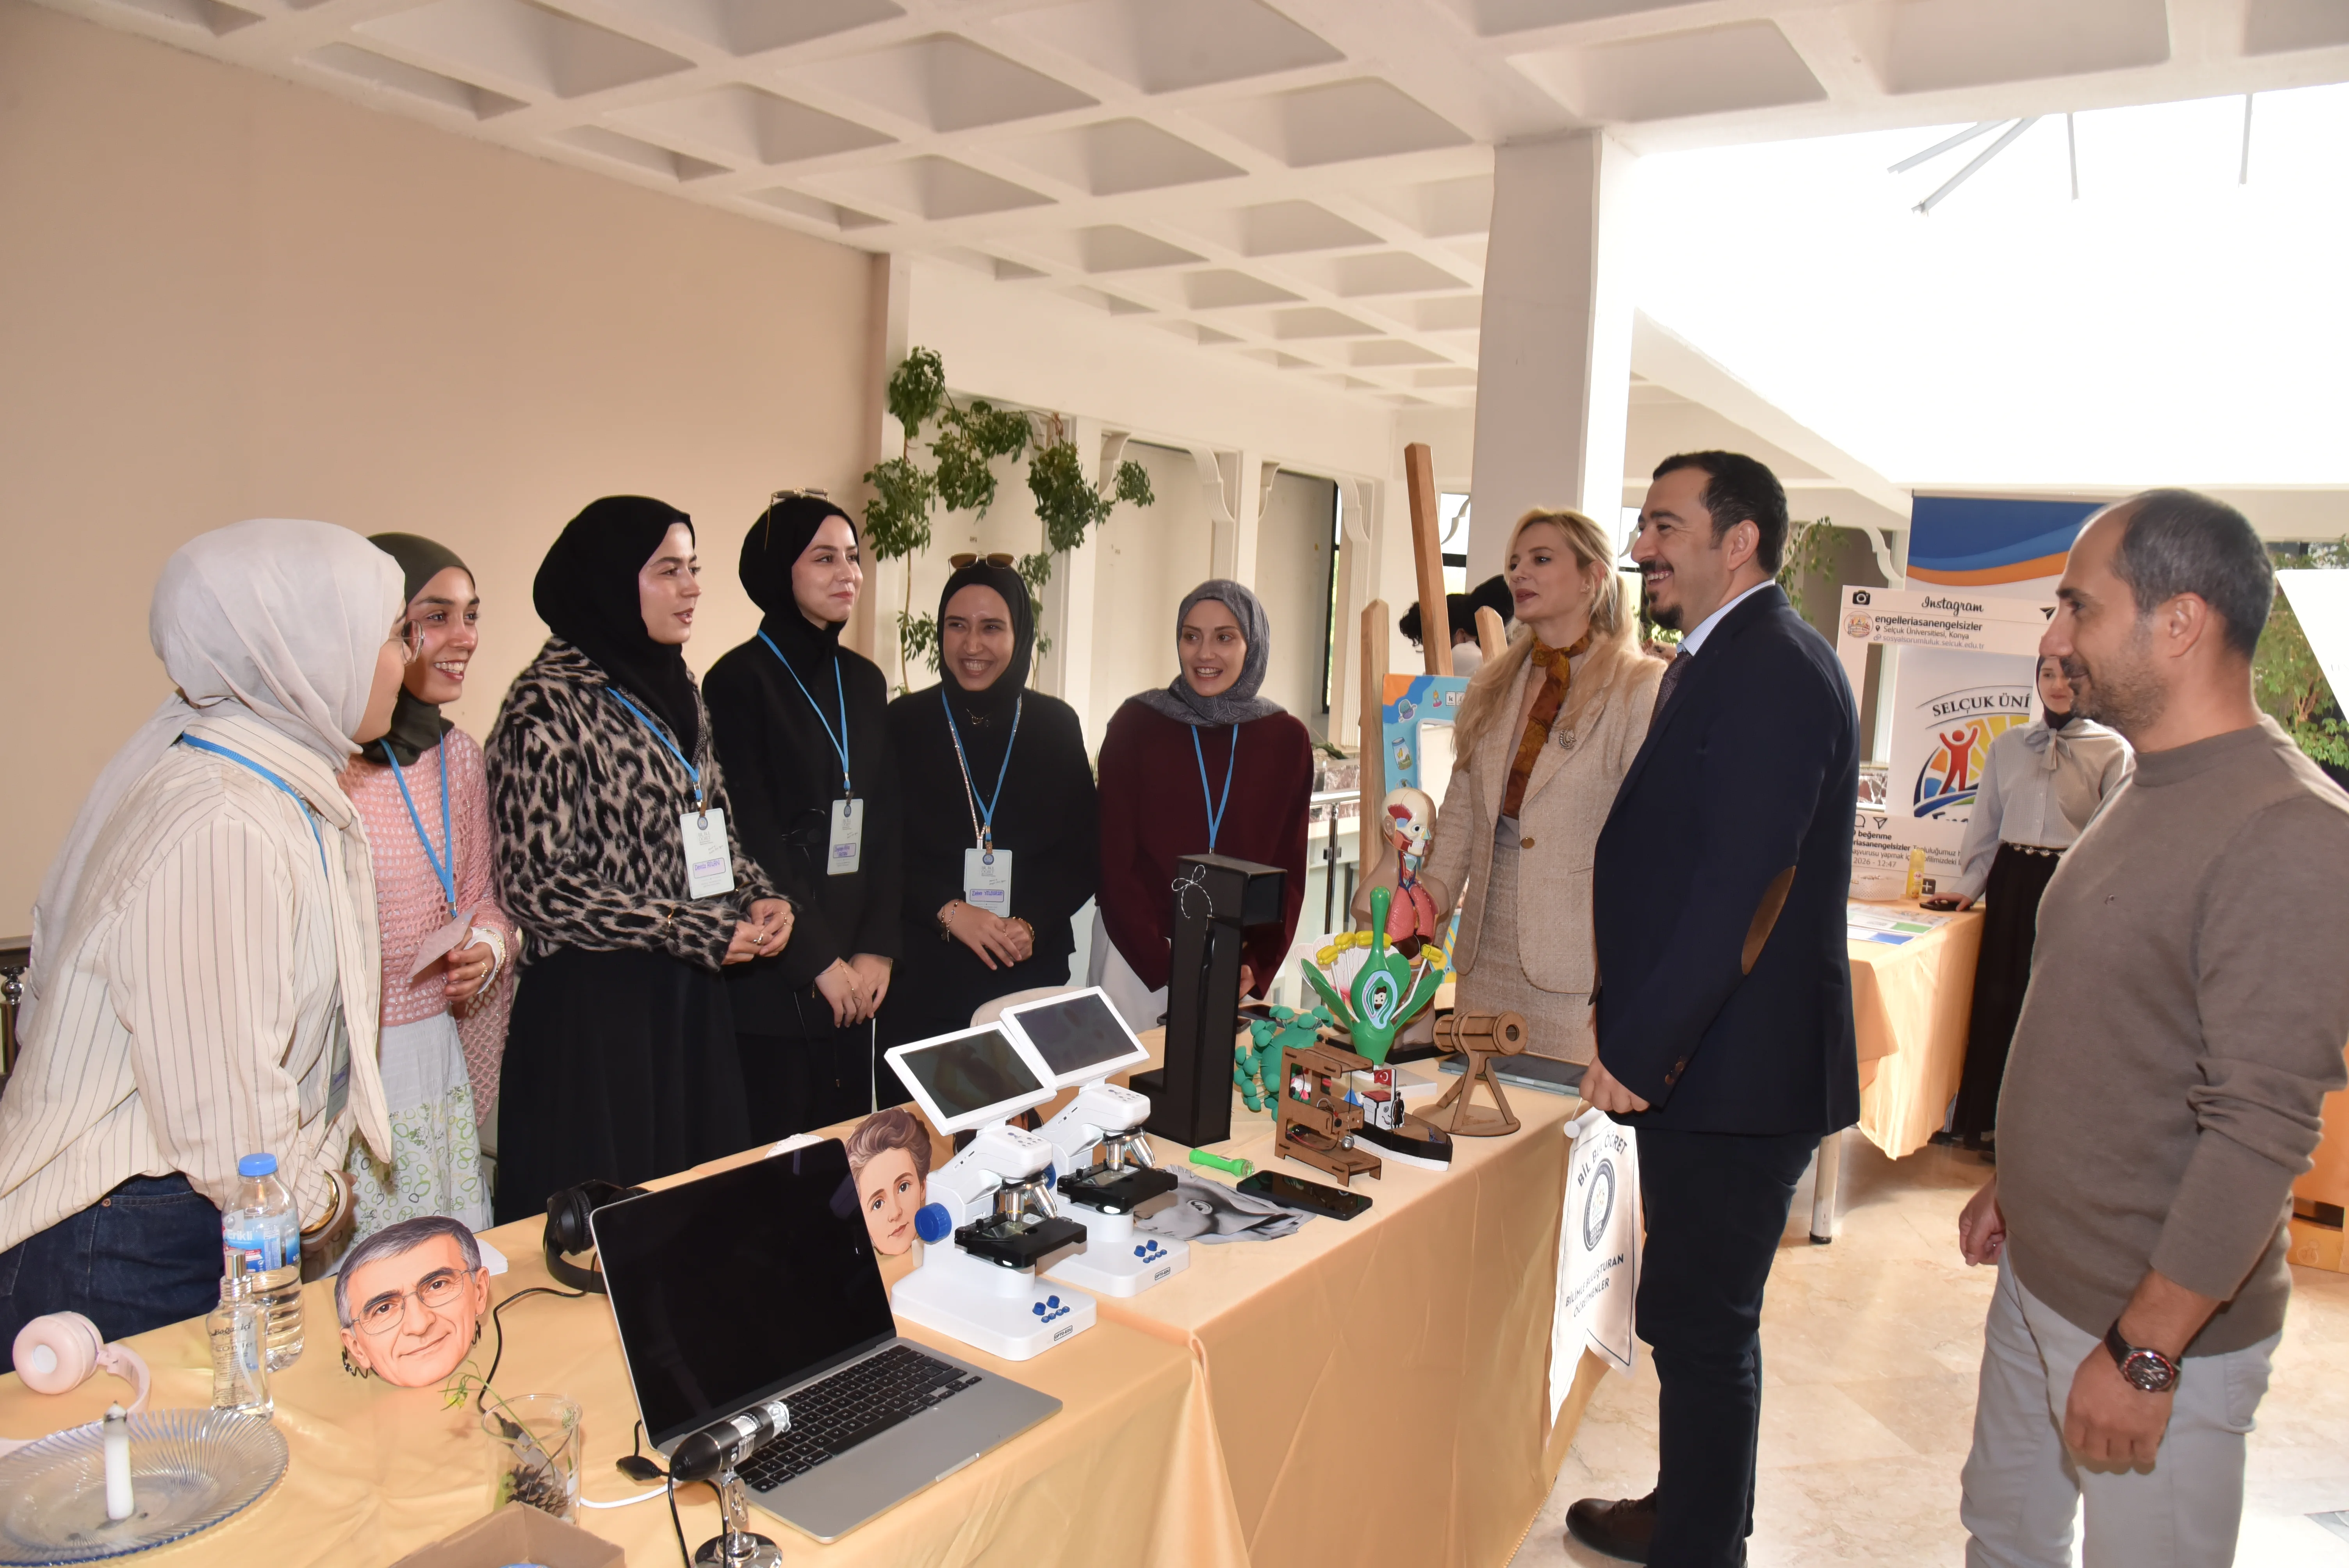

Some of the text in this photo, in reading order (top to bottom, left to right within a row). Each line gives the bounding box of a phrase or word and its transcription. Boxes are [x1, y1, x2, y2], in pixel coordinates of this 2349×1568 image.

[1921, 596, 1984, 616] Instagram
[1875, 615, 1982, 631] engelleriasanengelsizler
[1884, 625, 1904, 634] Selçuk
[1949, 631, 1969, 640] Konya
[1883, 635, 1984, 649] sosyalsorumluluk.selcuk.edu.tr
[1932, 692, 2030, 716] SELÇUK ÜNİ
[1858, 830, 1892, 839] beğenme
[1853, 839, 1911, 851] riasanengelsizler
[1577, 1162, 1591, 1187] BİL
[1604, 1130, 1627, 1155] ÖĞRET
[227, 1229, 253, 1241] Erikli
[1156, 1268, 1170, 1278] OPTO-EDU
[1566, 1253, 1624, 1307] BİLİMLE BULUŞTURAN
[1574, 1278, 1609, 1317] ÖĞRETMENLER
[213, 1322, 251, 1336] Boğaiçi
[1055, 1327, 1072, 1339] OPTO-EDU
